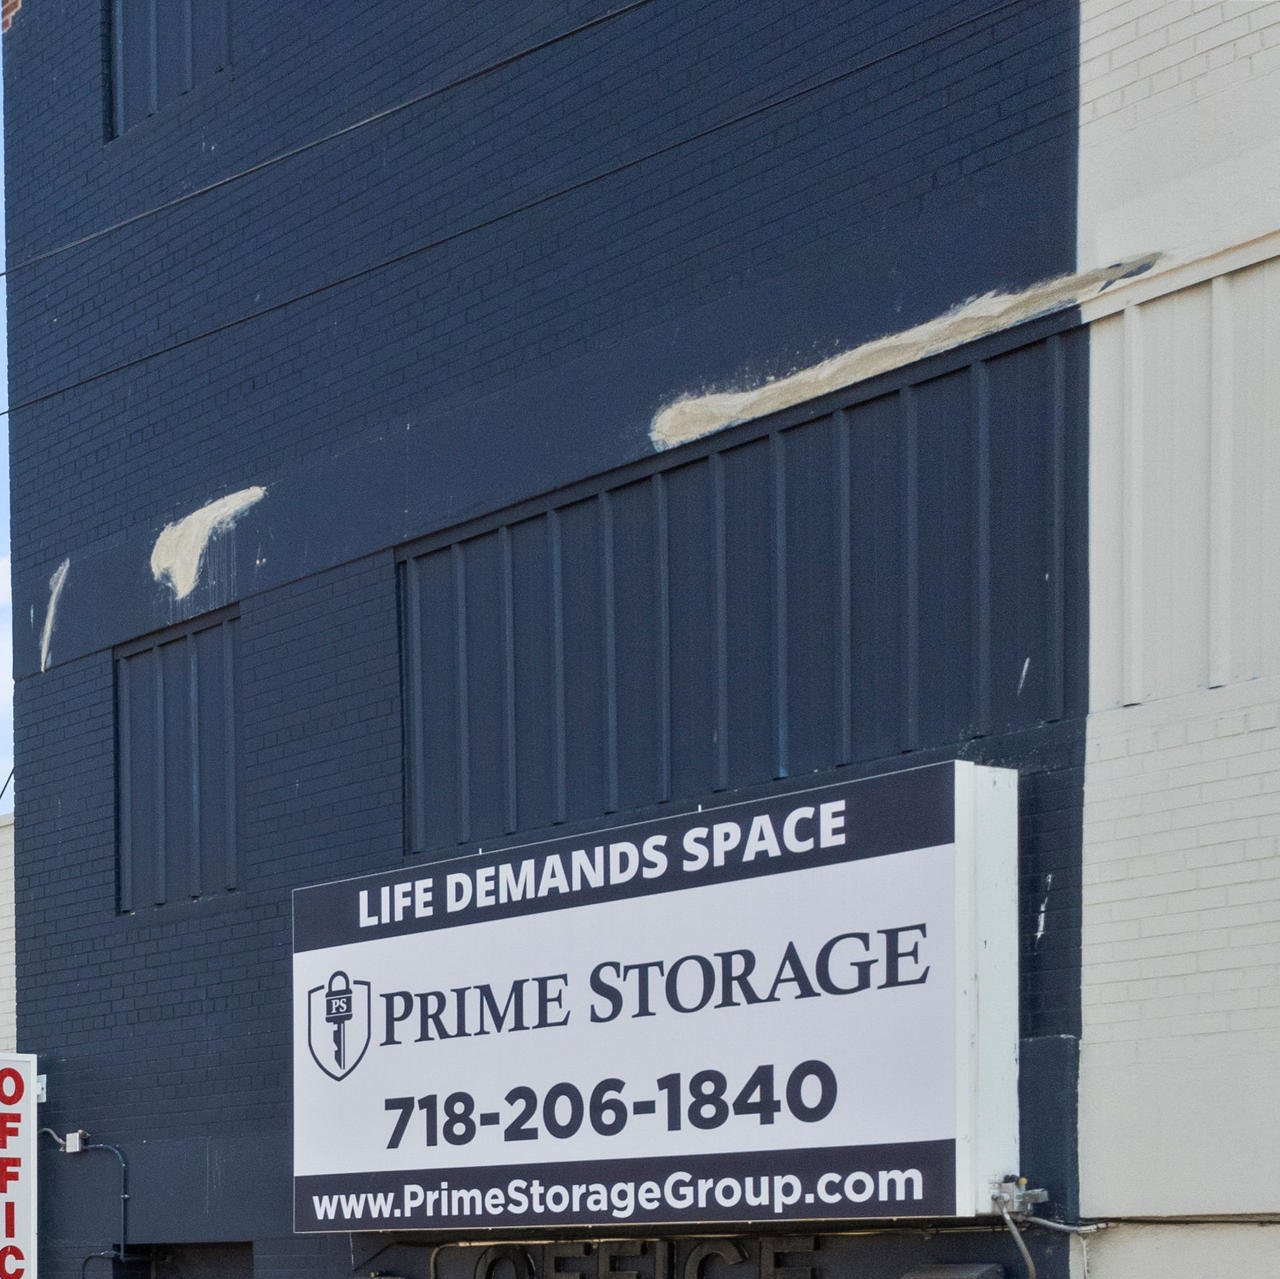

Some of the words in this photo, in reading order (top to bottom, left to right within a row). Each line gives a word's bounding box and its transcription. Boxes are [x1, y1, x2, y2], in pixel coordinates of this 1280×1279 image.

[359, 877, 434, 929] LIFE
[446, 835, 668, 914] DEMANDS
[682, 799, 846, 872] SPACE
[331, 998, 347, 1013] PS
[379, 973, 571, 1047] PRIME
[589, 922, 930, 1023] STORAGE
[384, 1059, 838, 1150] 718-206-1840
[312, 1168, 924, 1220] www.PrimeStorageGroup.com
